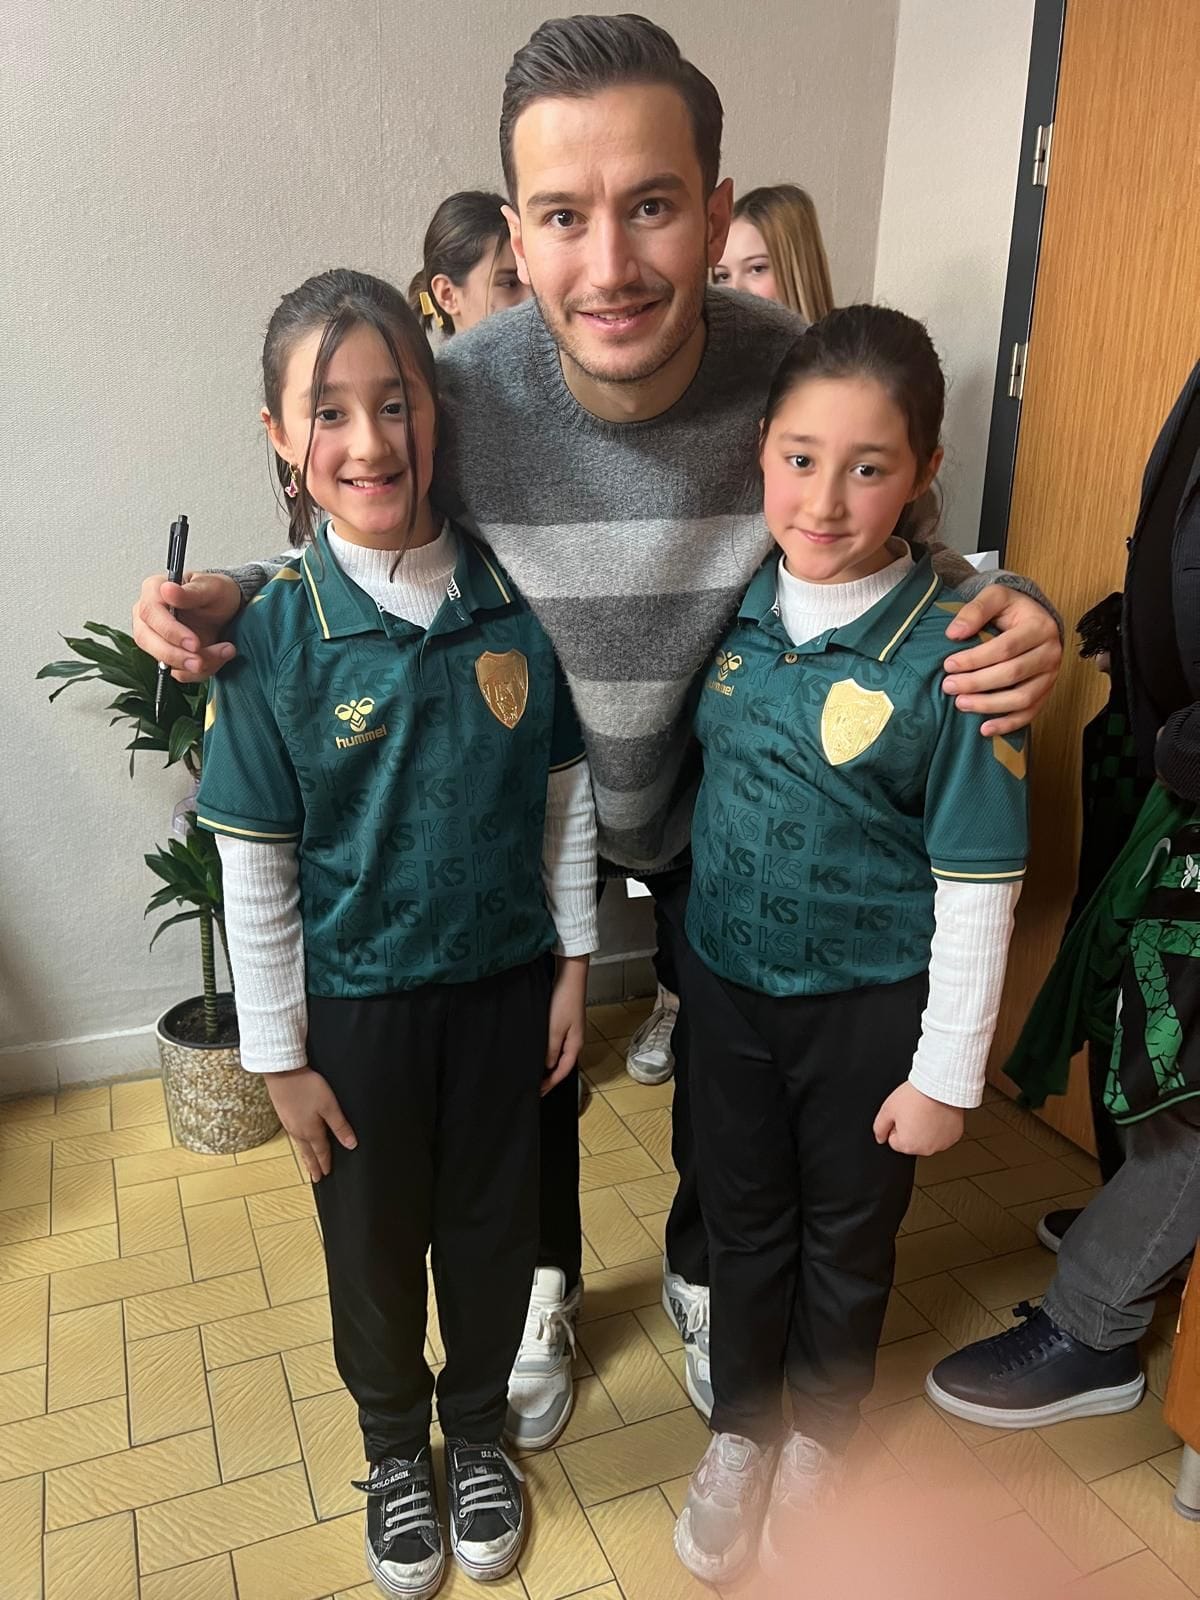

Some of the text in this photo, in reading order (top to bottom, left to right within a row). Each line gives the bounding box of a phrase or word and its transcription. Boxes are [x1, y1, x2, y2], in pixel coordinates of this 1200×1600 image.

[335, 724, 387, 749] hummel
[416, 777, 460, 810] KS
[732, 768, 764, 803] KS
[767, 778, 810, 815] KS
[726, 804, 761, 842] KS
[765, 817, 807, 850] KS
[374, 822, 416, 858] KS
[425, 857, 468, 889] KS
[724, 841, 757, 878] KS
[762, 853, 802, 890] KS
[723, 877, 754, 914] KS
[809, 864, 851, 895] KS
[382, 900, 423, 928] KS
[760, 891, 799, 925] KS
[855, 904, 895, 932] KS
[721, 911, 753, 946] KS
[758, 926, 798, 959] KS
[804, 936, 846, 966] KS
